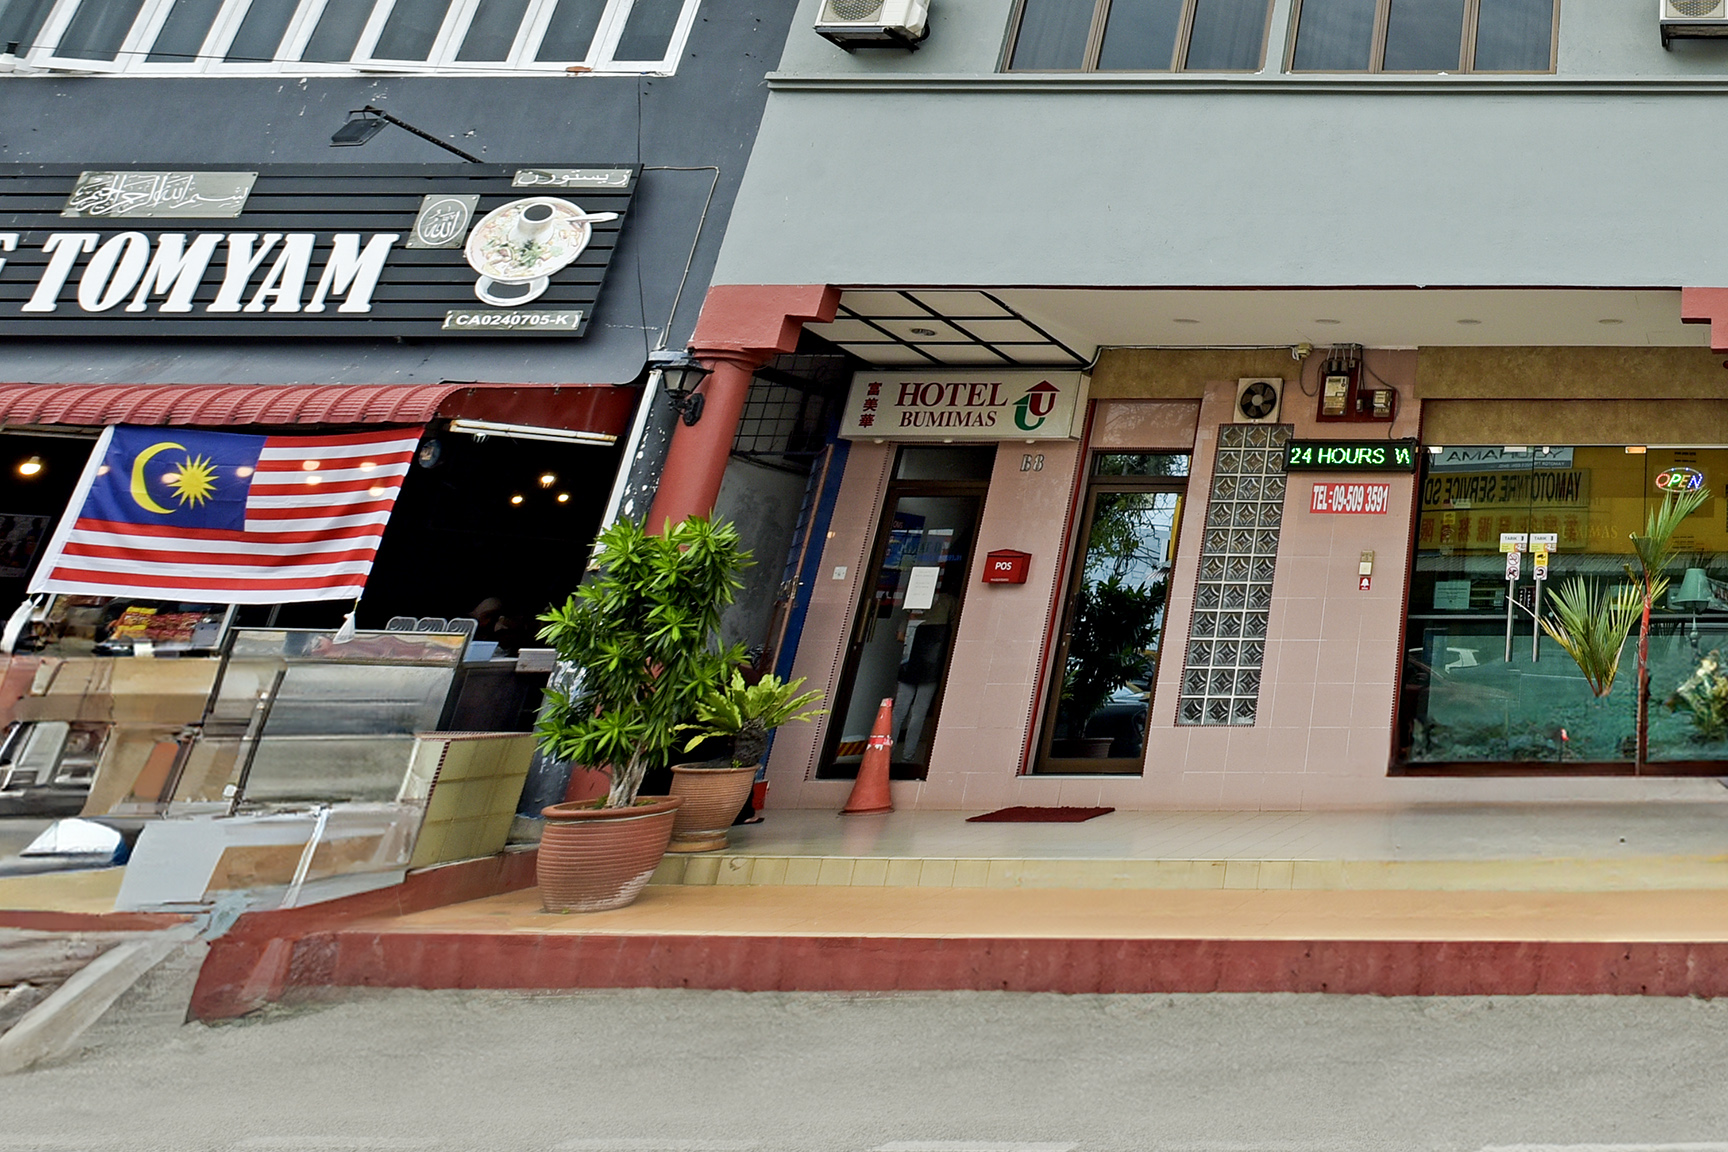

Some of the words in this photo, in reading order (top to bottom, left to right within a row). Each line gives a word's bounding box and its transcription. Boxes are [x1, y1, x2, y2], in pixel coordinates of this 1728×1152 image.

[21, 233, 400, 313] TOMYAM
[859, 381, 883, 428] 富美華
[895, 382, 1009, 407] HOTEL
[899, 410, 998, 428] BUMIMAS
[1289, 447, 1312, 464] 24
[1317, 447, 1385, 464] HOURS
[1656, 473, 1703, 489] OPEN
[1365, 485, 1389, 512] 3591
[995, 561, 1013, 571] POS
